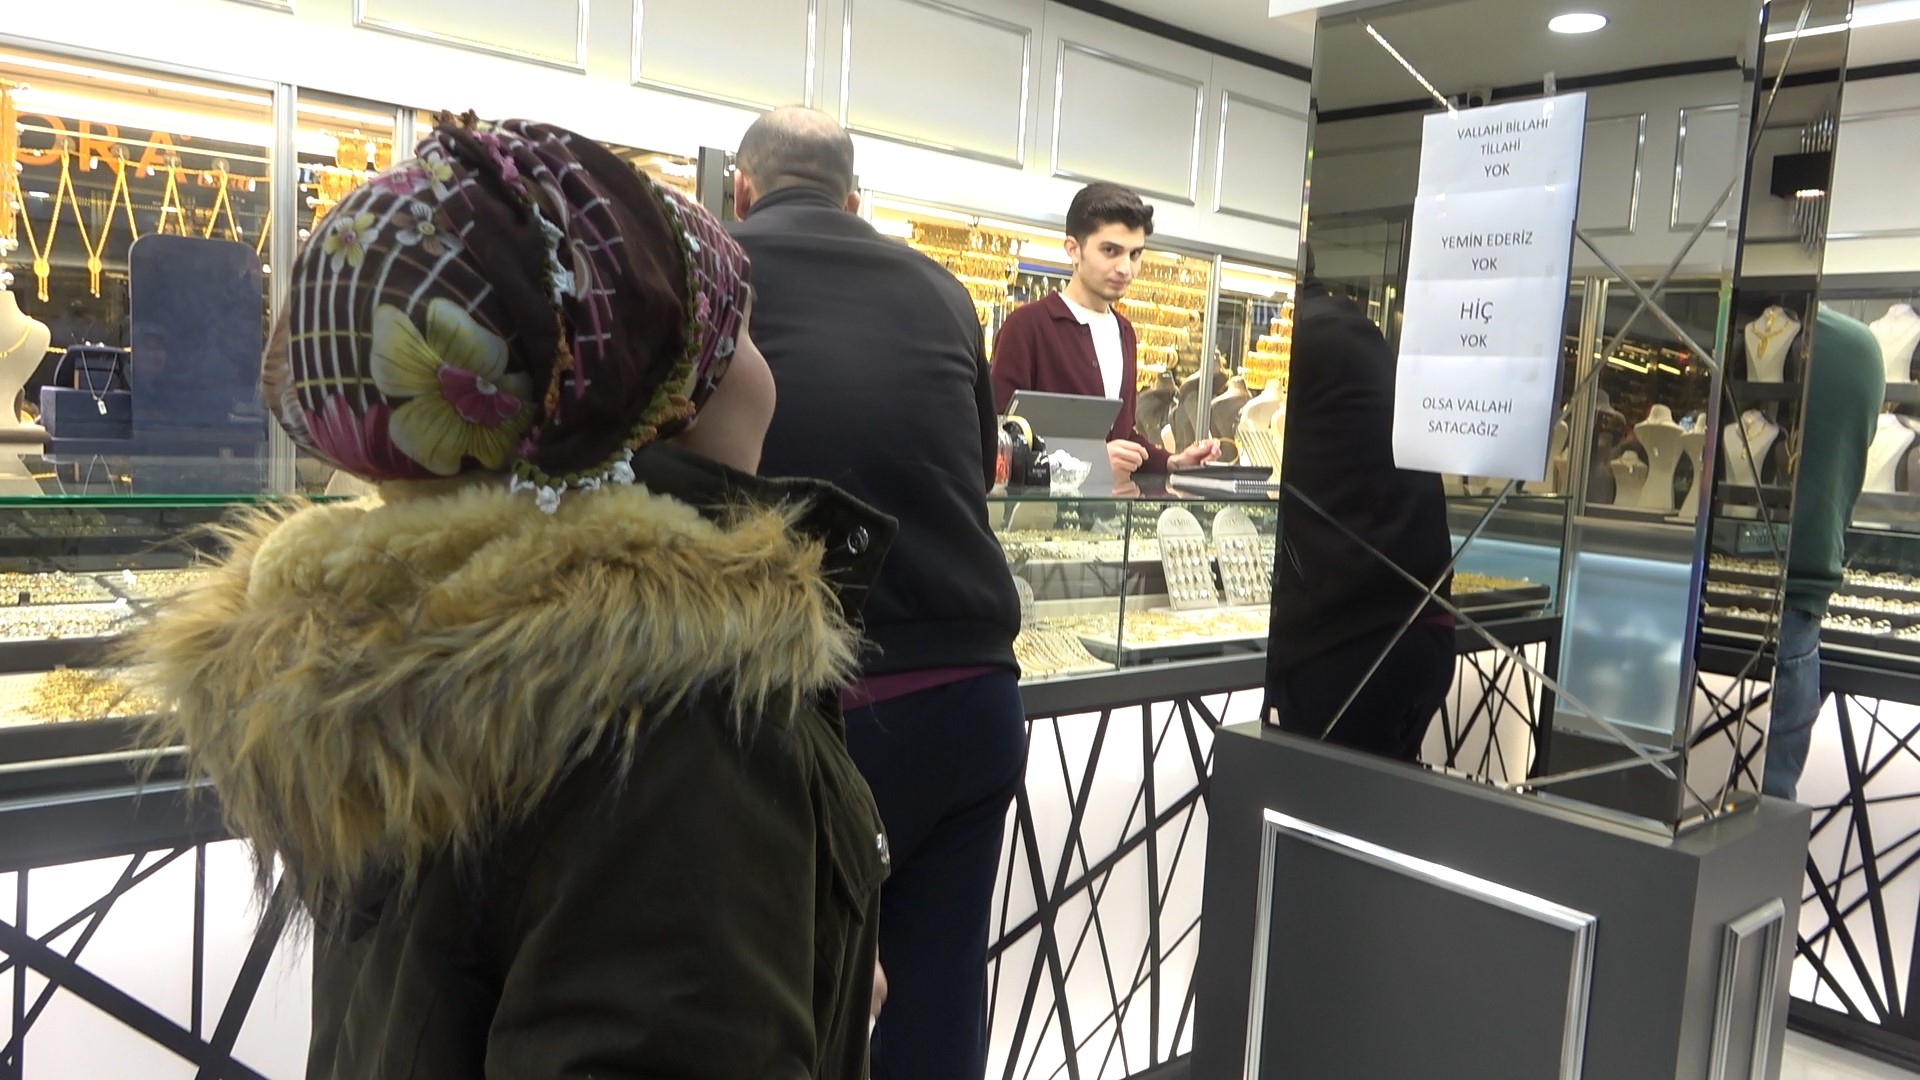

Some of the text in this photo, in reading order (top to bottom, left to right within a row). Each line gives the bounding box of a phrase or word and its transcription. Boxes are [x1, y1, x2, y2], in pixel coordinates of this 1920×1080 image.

[1480, 140, 1521, 156] TİLLAHİ
[1484, 163, 1510, 178] YOK
[1441, 229, 1533, 249] YEMİN EDERİZ
[1471, 257, 1498, 272] YOK
[1460, 298, 1494, 324] HİÇ
[1460, 334, 1488, 348] YOK
[1422, 397, 1513, 414] OLSA VALLAHİ
[1427, 420, 1499, 437] SATACAĞIZ
